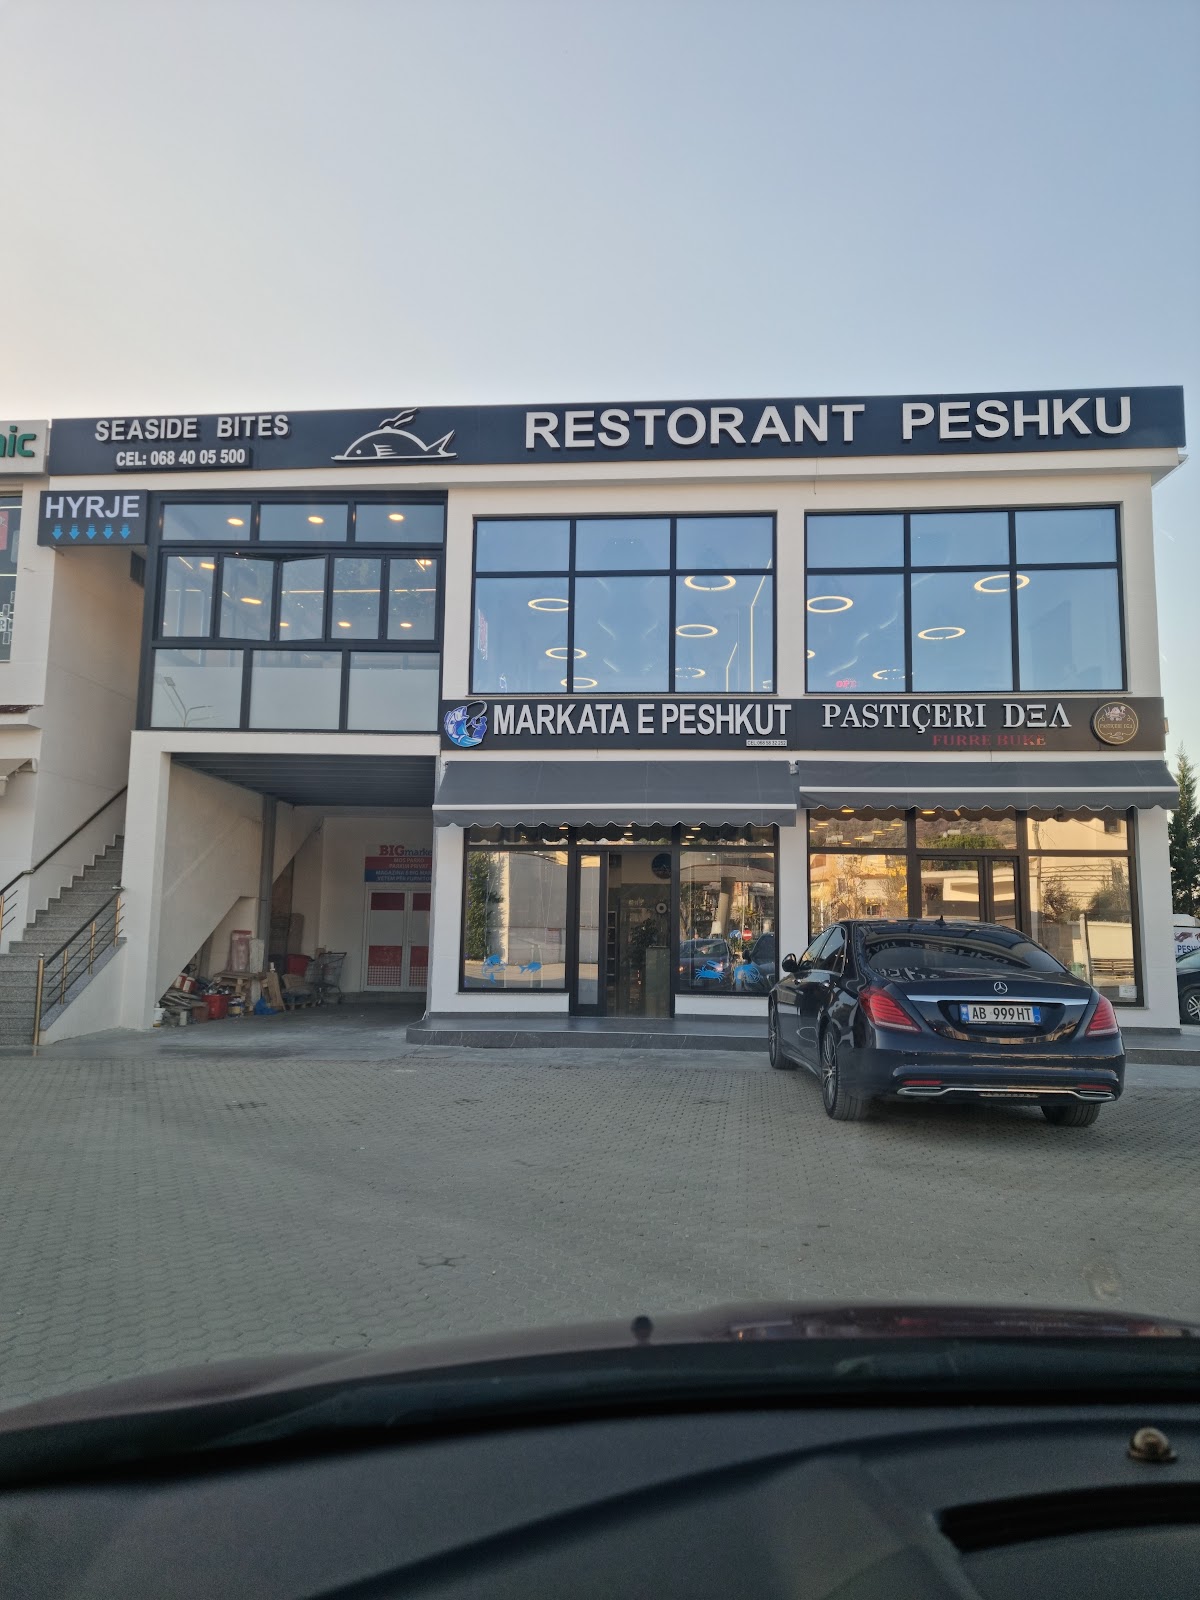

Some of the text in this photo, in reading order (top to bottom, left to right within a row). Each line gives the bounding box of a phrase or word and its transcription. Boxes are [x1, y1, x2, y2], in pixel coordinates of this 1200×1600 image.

[95, 415, 289, 441] SEASIDE BITES
[525, 396, 1131, 449] RESTORANT PESHKU
[116, 448, 246, 466] CEL: 068 40 05 500
[45, 495, 140, 519] HYRJE
[493, 703, 792, 736] MARKATA E PESHKUT
[821, 703, 987, 733] PASTIÇERI
[973, 1007, 987, 1019] AB
